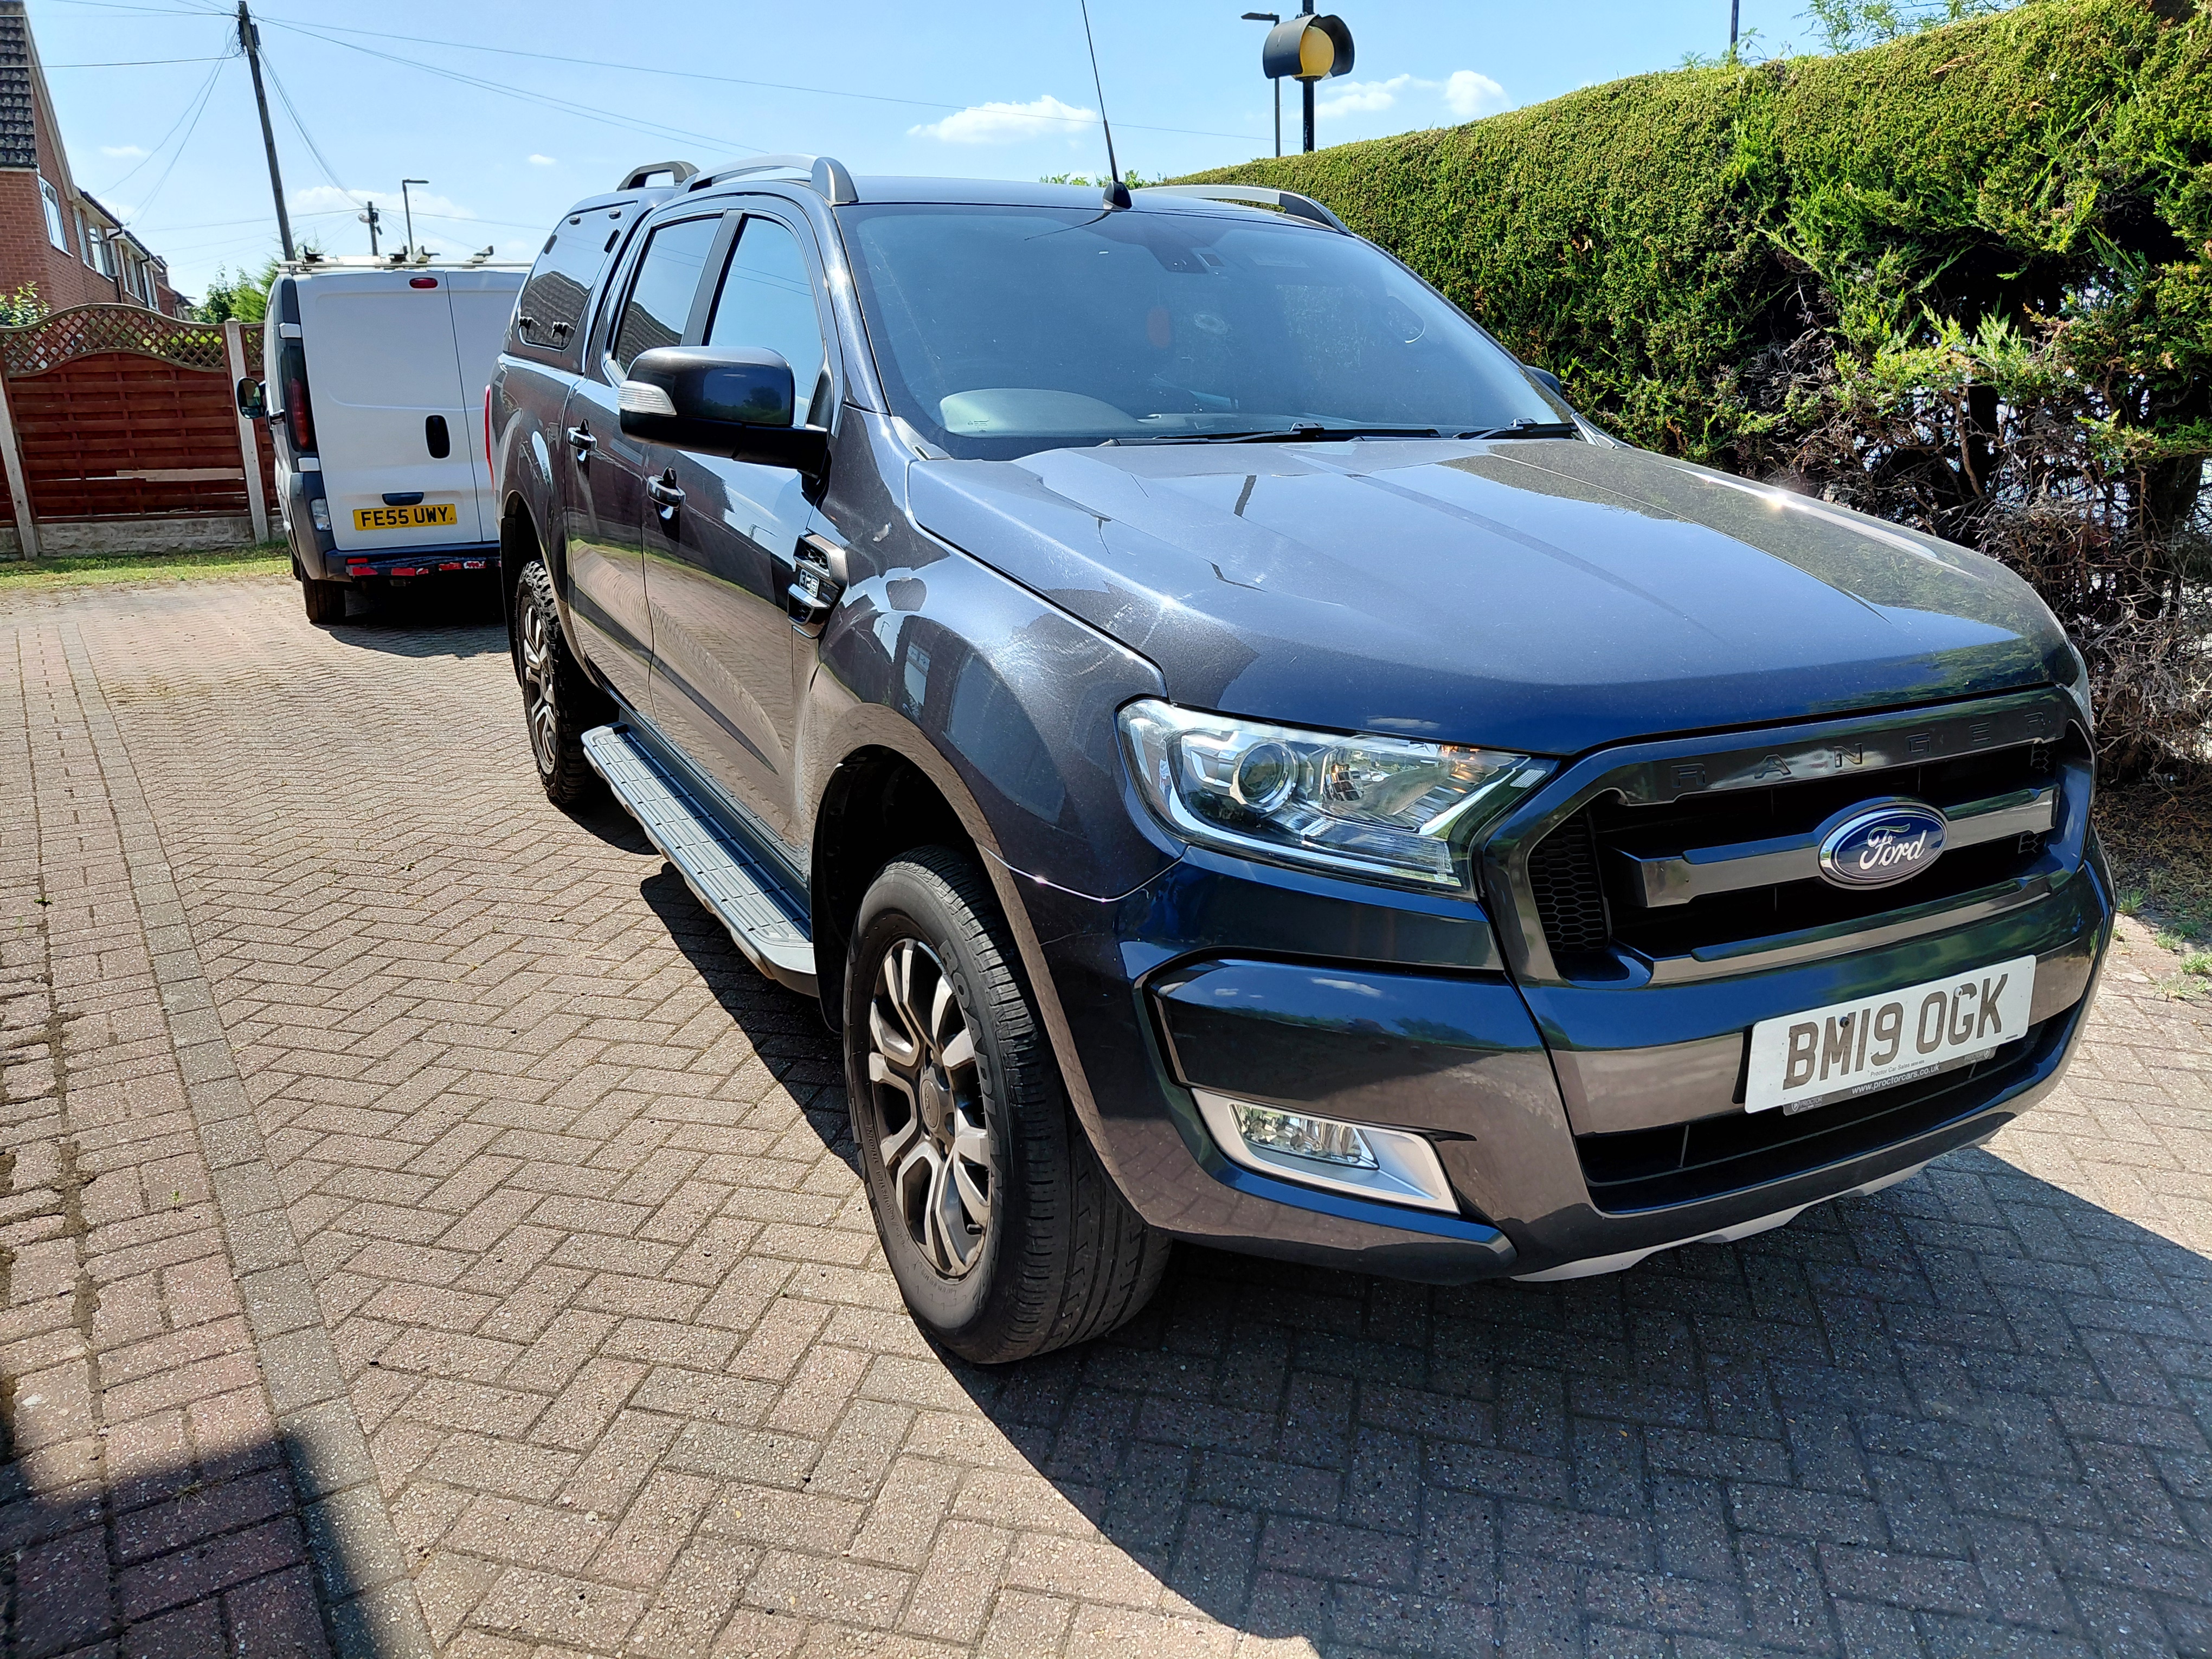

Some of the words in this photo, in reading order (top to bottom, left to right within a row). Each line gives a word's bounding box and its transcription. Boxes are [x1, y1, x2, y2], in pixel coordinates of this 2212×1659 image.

[361, 509, 409, 527] FE55
[414, 506, 448, 524] UWY
[1671, 711, 2045, 789] RANGER
[1859, 822, 1928, 870] Ford
[1782, 1001, 1904, 1091] BM19
[1916, 973, 2009, 1055] OGK
[1851, 1064, 1940, 1095] www.proctorcars.co.uk
[1870, 1066, 1888, 1077] Proctor
[1898, 1063, 1910, 1071] Sales
